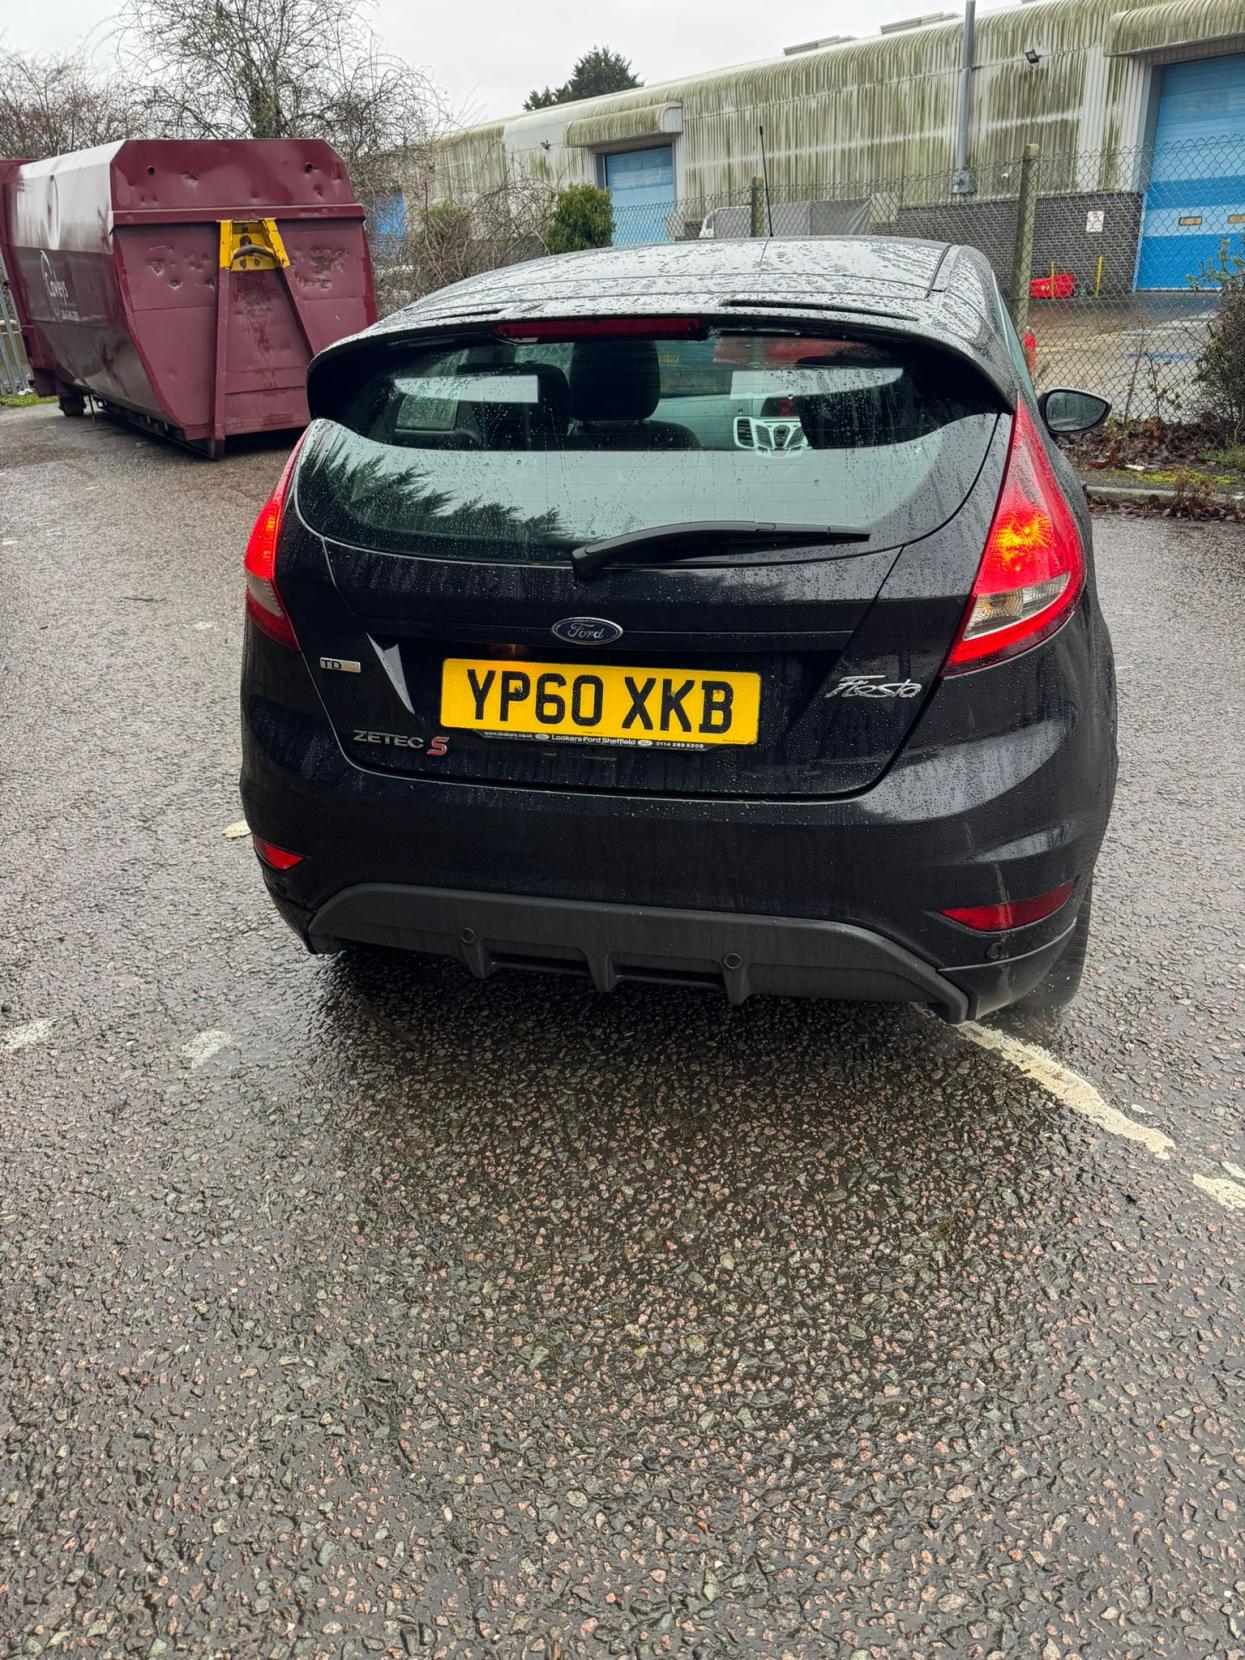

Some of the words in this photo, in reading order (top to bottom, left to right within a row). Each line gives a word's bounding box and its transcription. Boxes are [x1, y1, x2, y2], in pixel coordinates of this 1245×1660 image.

[567, 622, 605, 639] Ford
[824, 674, 922, 698] Fiesta
[467, 669, 604, 727] YP60
[622, 676, 734, 734] XKB
[353, 729, 425, 749] ZETEC
[426, 736, 450, 757] S
[551, 734, 583, 743] Lookers
[583, 736, 601, 744] Ford
[602, 738, 636, 746] Sheffield
